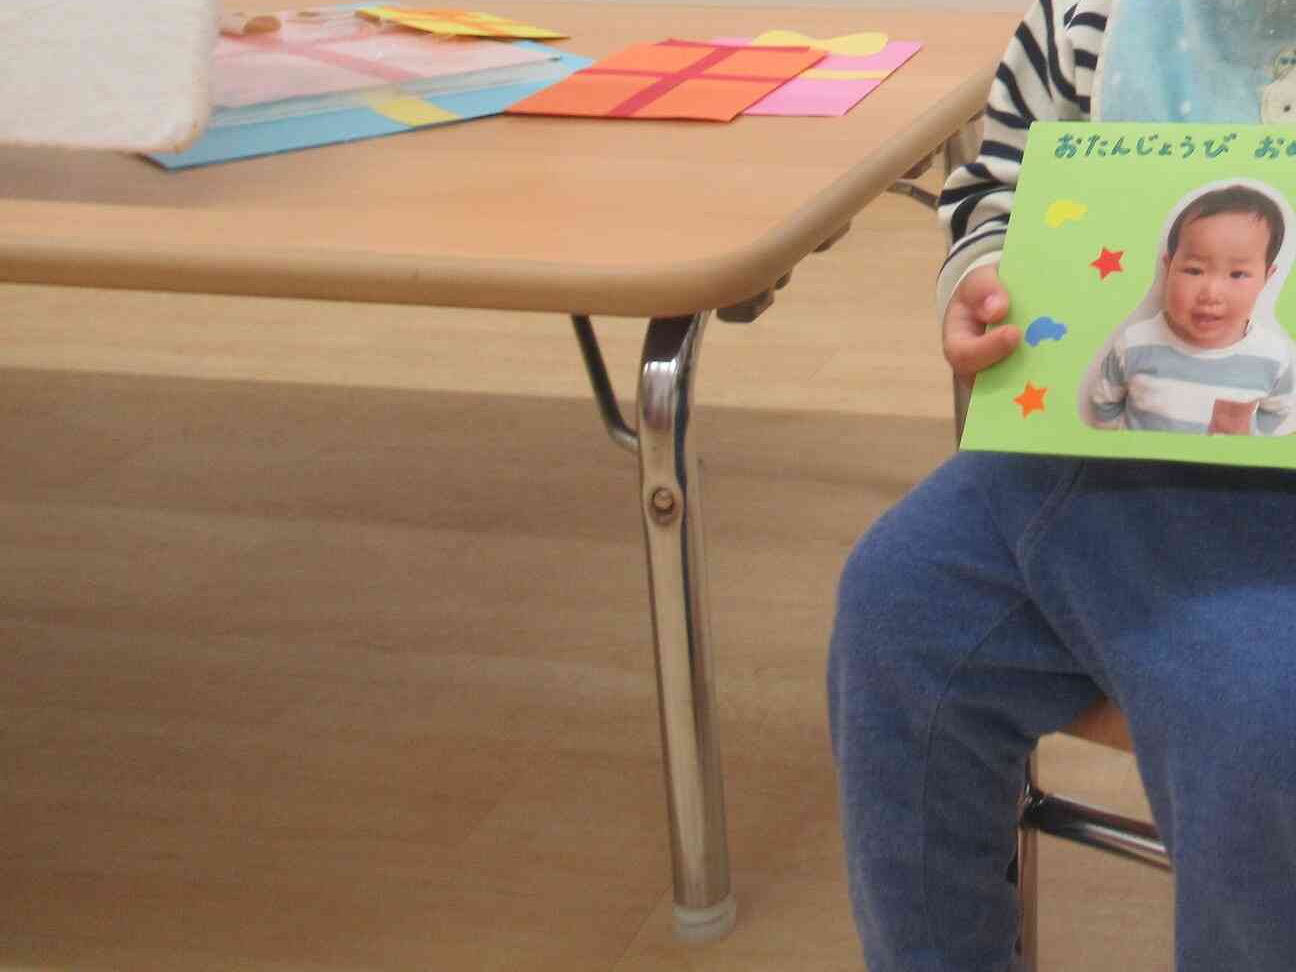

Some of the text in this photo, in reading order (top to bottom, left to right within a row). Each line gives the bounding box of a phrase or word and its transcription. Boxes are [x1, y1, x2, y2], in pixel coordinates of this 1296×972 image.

[1054, 133, 1237, 159] おたんじょうび
